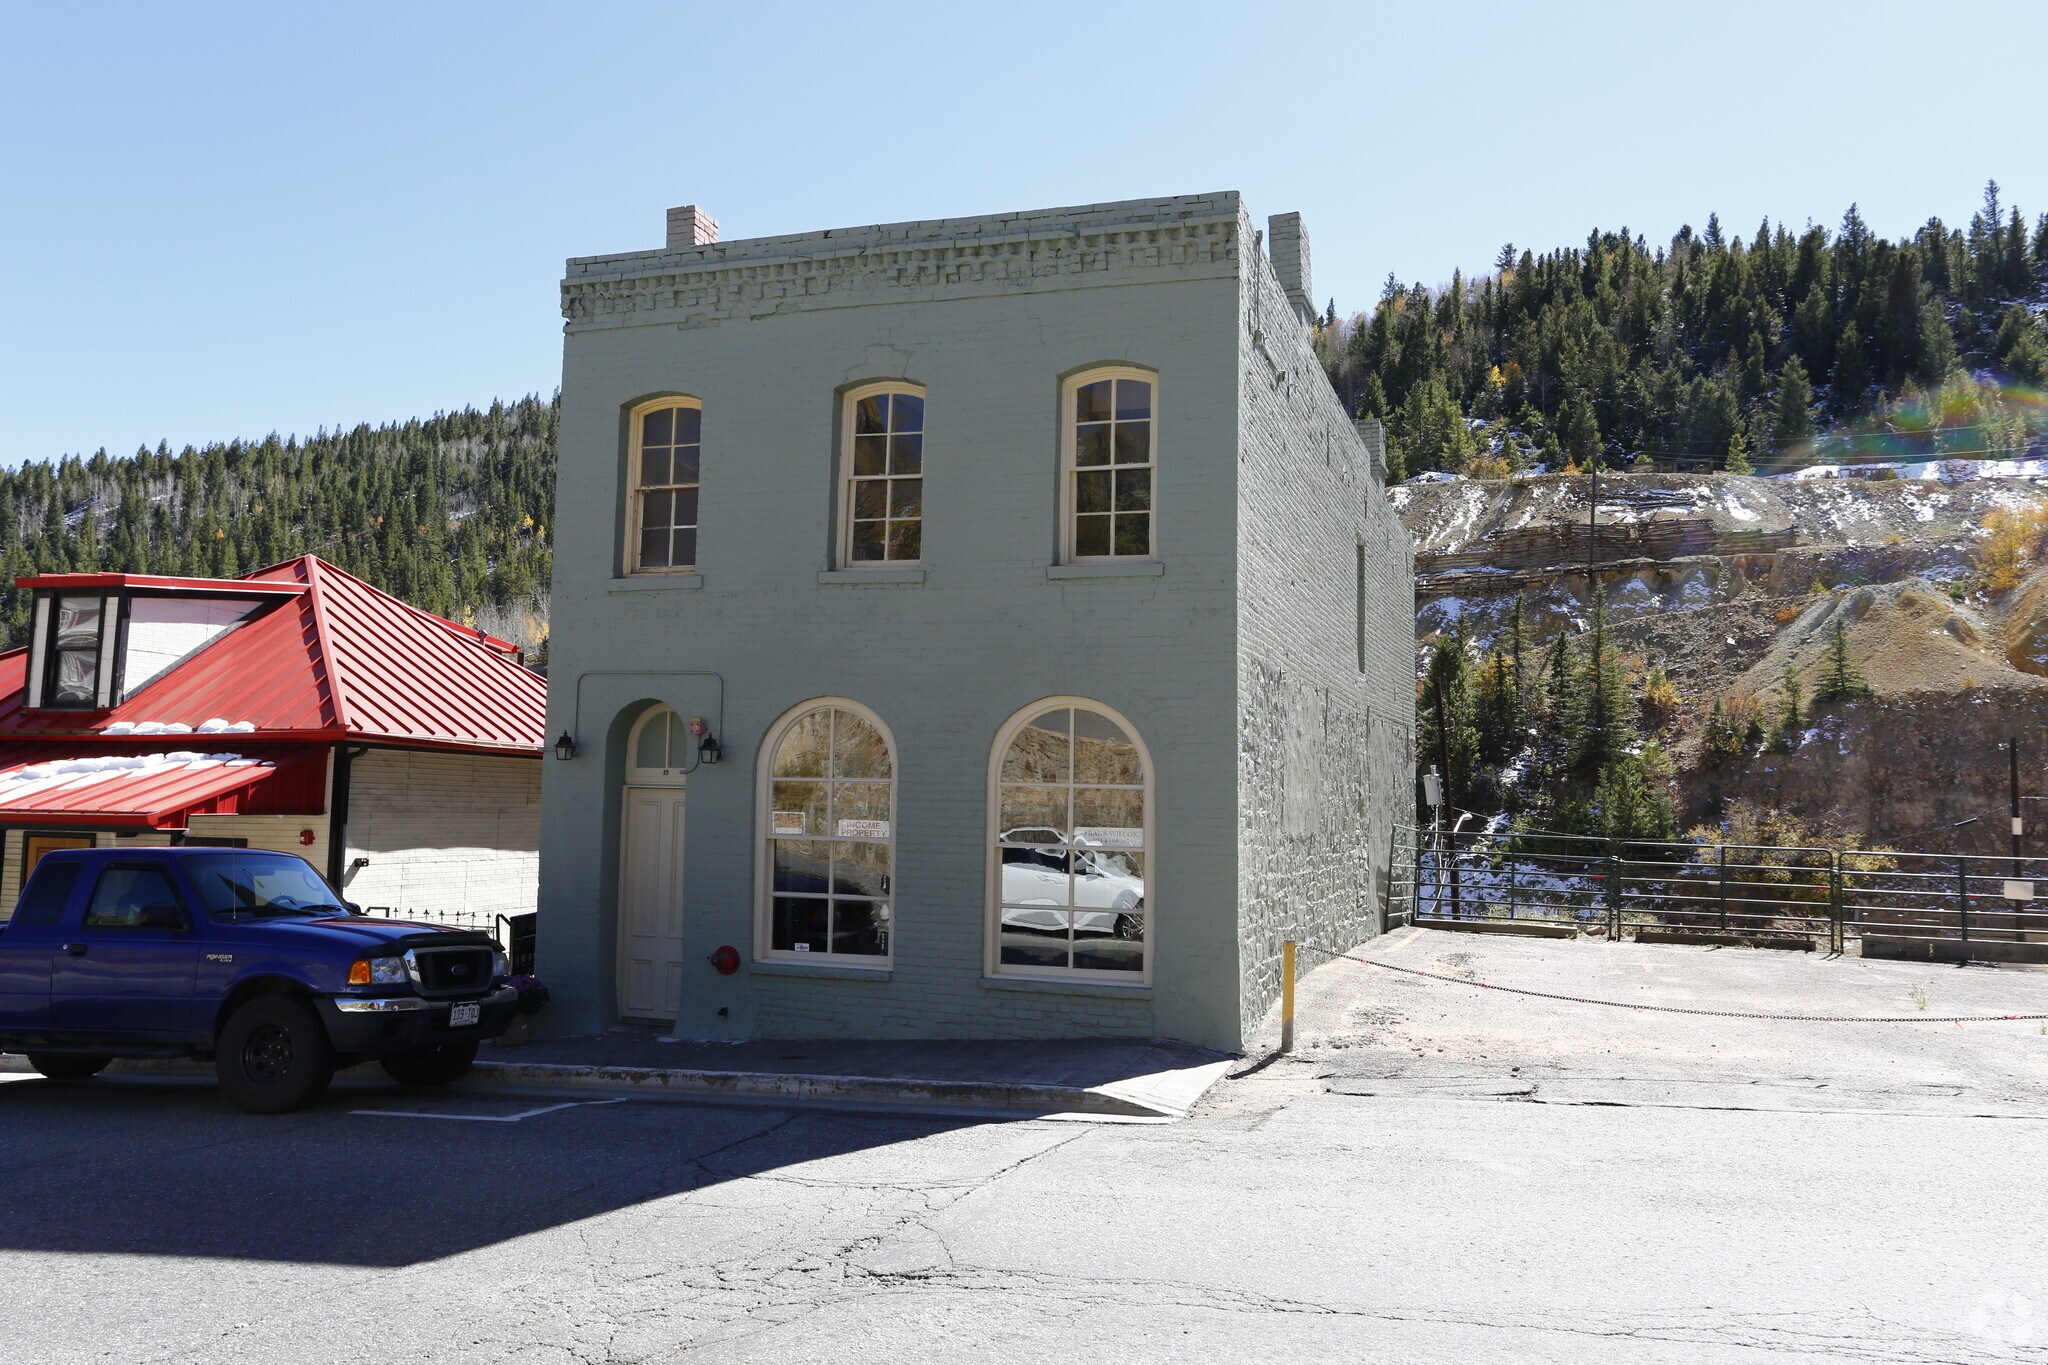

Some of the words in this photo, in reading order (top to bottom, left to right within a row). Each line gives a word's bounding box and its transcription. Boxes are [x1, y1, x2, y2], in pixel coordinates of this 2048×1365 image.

[846, 821, 881, 829] INCOME
[841, 829, 887, 837] PROPERTY
[1109, 830, 1138, 838] WILCOX
